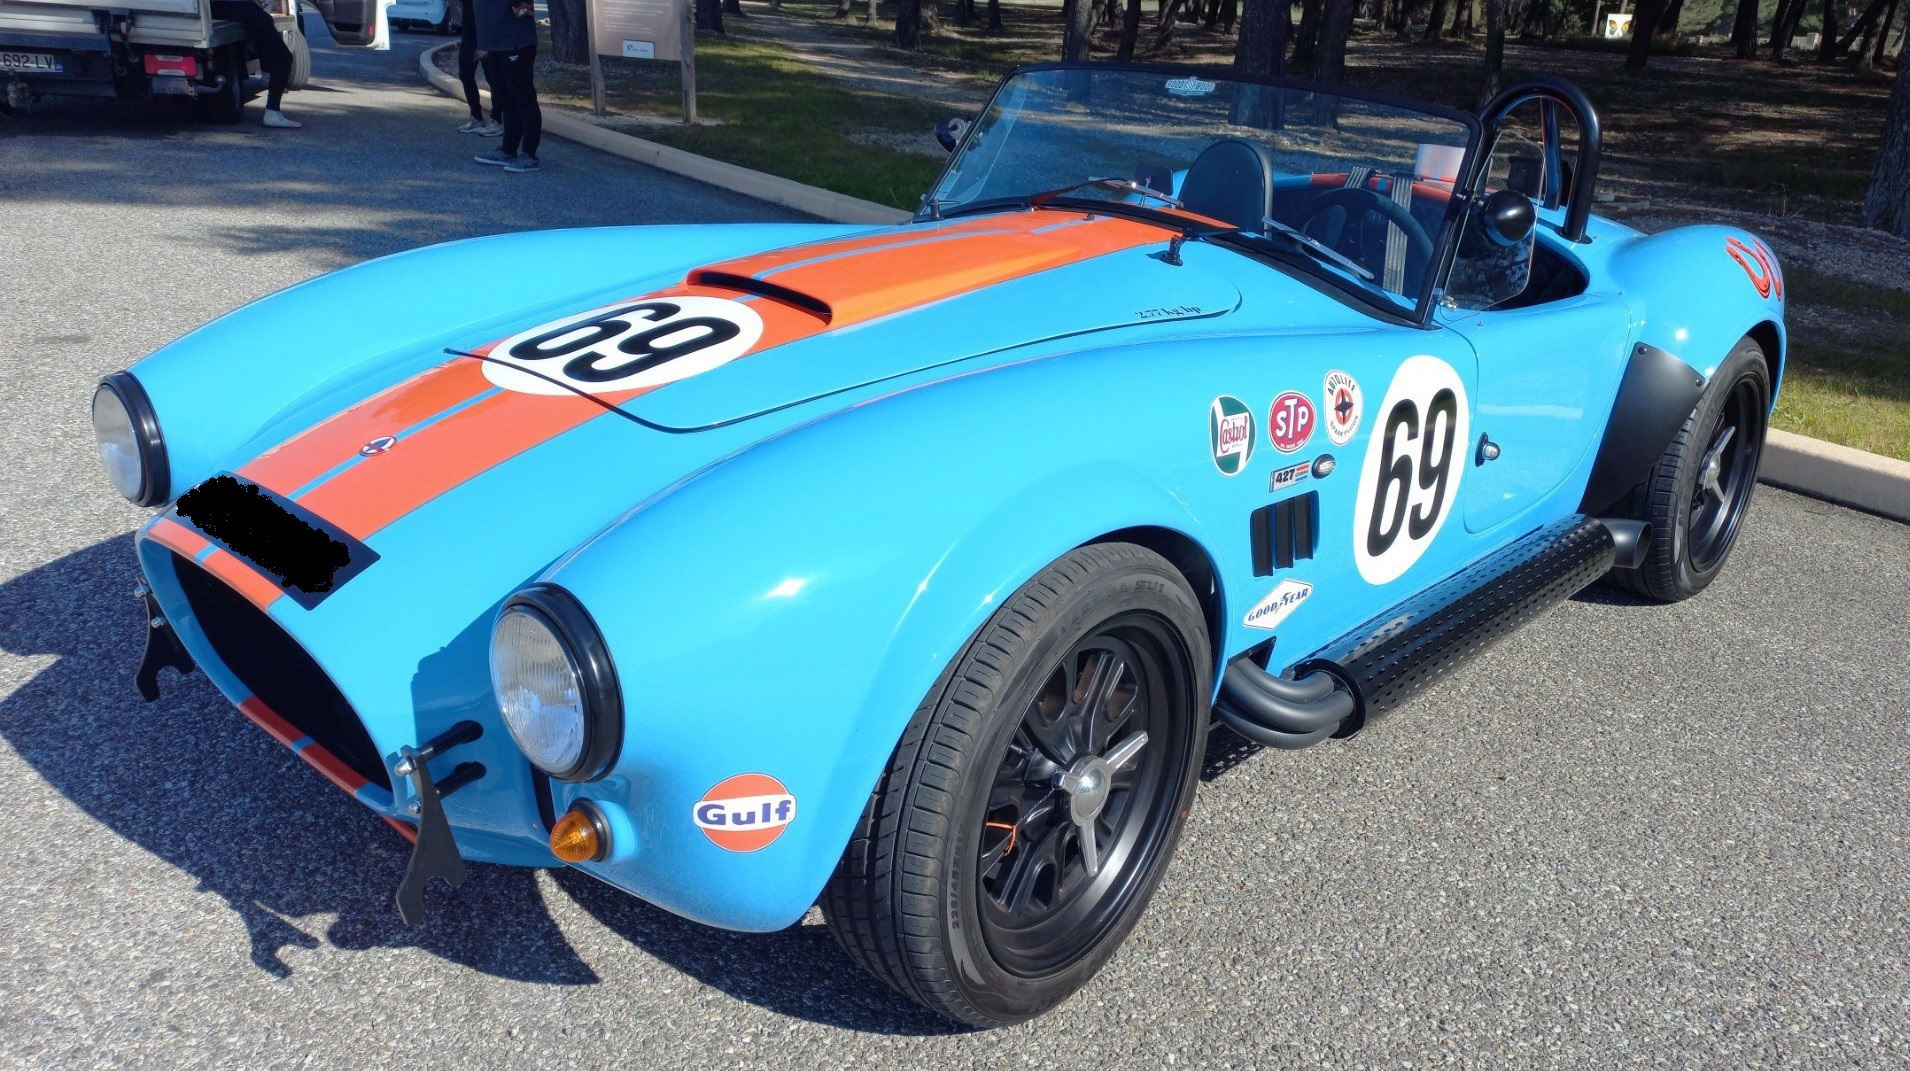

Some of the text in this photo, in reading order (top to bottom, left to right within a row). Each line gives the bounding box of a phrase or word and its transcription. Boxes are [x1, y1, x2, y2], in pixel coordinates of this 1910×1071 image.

[508, 302, 741, 383] 69
[1327, 374, 1356, 396] AUTOLITE
[1220, 415, 1248, 455] Castrol
[1275, 398, 1309, 439] STP
[1275, 468, 1296, 484] 427
[1366, 387, 1458, 558] 69
[697, 799, 792, 826] Gulf
